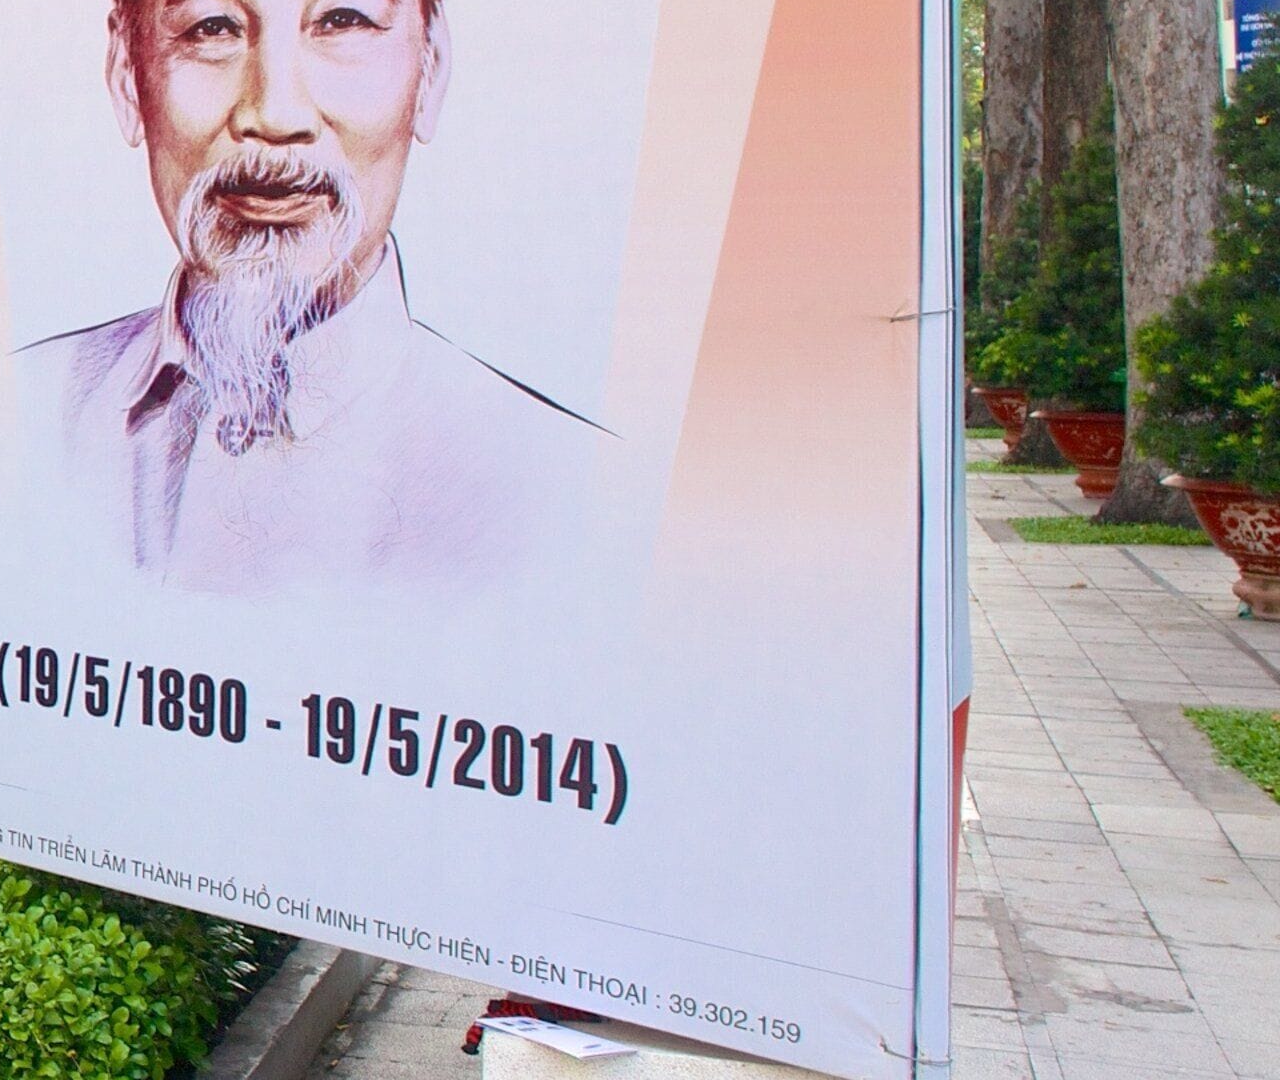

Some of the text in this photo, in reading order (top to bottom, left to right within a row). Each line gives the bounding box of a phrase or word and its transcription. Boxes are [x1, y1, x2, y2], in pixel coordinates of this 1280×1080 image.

[266, 719, 281, 730] -
[301, 693, 628, 825] 19/5/2014)
[8, 830, 33, 851] TIN
[37, 834, 87, 864] TRIỂN
[91, 849, 126, 874] LÃM
[131, 860, 192, 890] THÀNH
[197, 876, 238, 901] PHỐ
[242, 883, 271, 910] HỒ
[276, 896, 310, 920] CHÍ
[315, 906, 367, 935] MINH
[373, 919, 431, 951] THỰC
[438, 936, 490, 967] HIỆN
[511, 954, 566, 984] ĐIỆN
[573, 969, 647, 1005] THOẠI
[668, 994, 801, 1044] 39.302.159
